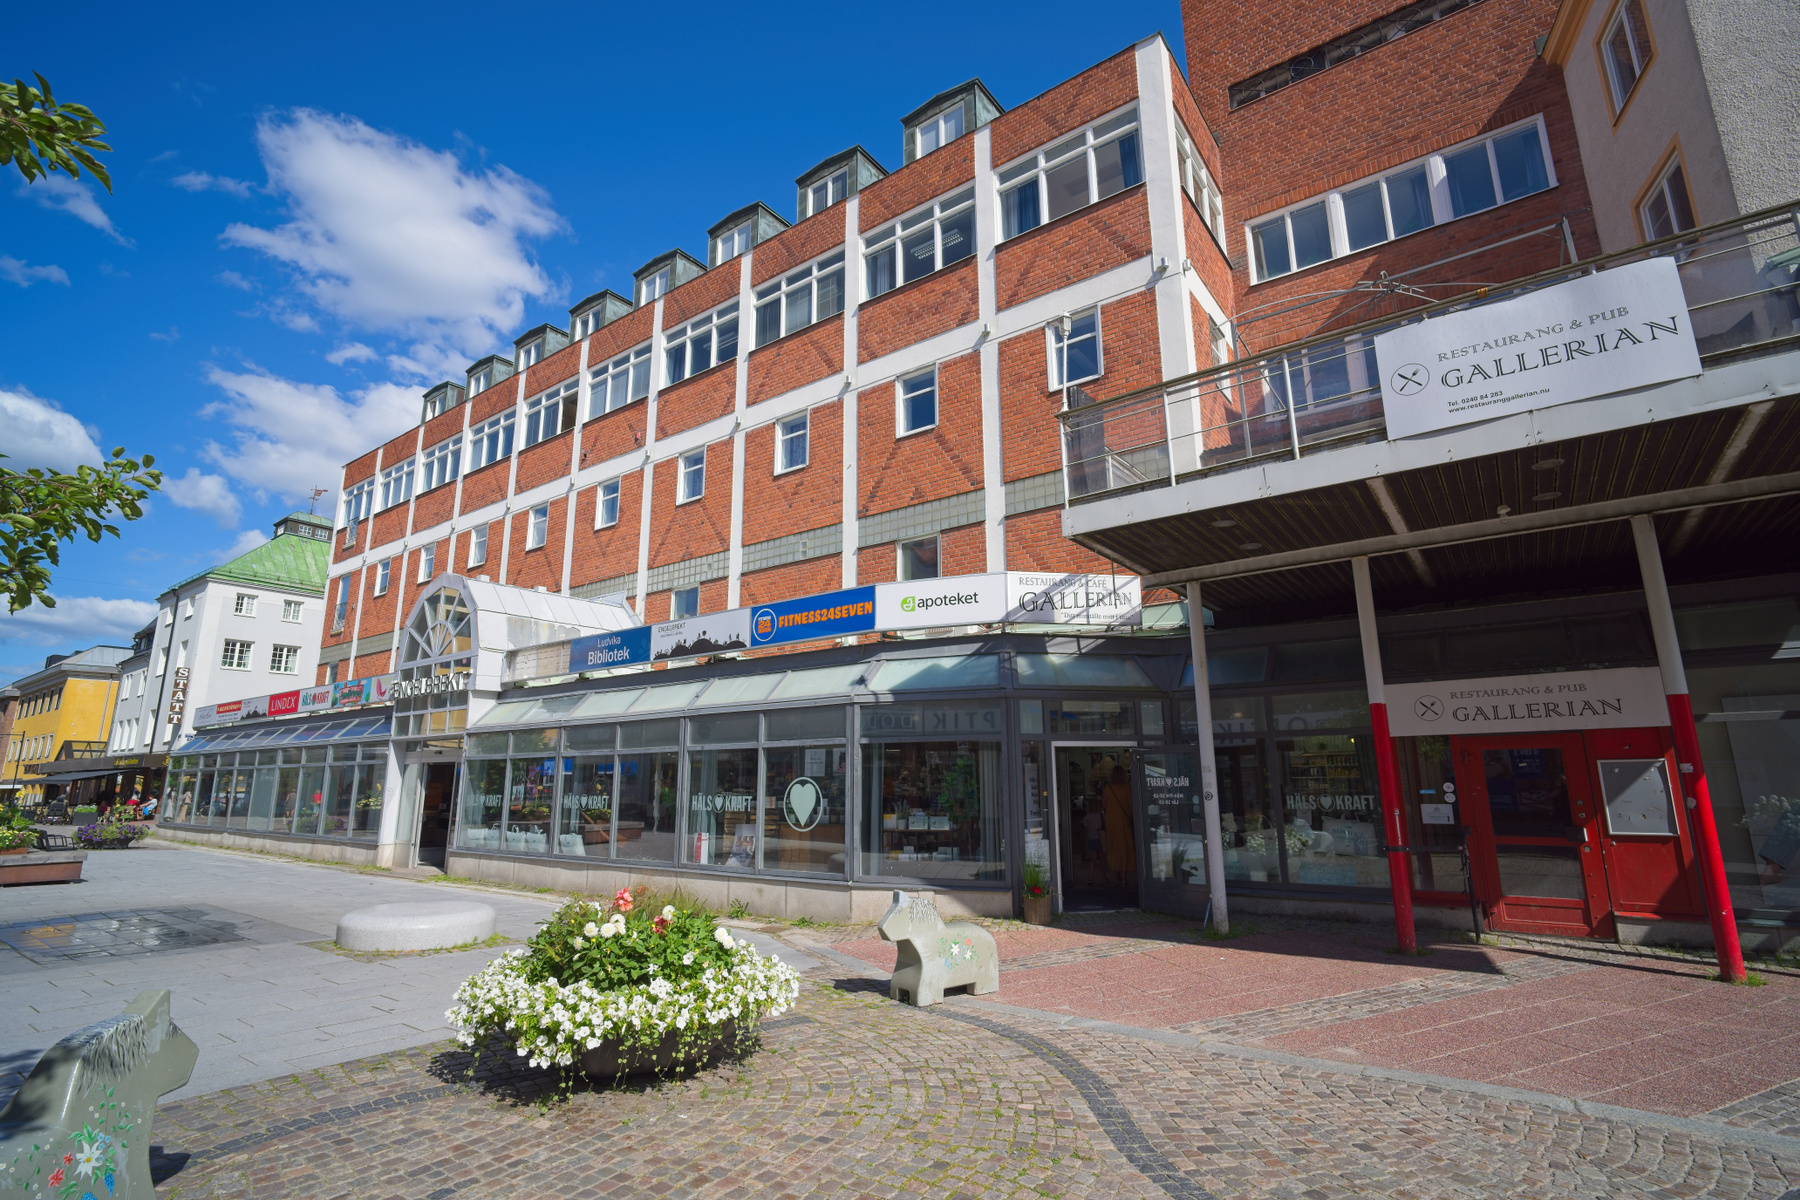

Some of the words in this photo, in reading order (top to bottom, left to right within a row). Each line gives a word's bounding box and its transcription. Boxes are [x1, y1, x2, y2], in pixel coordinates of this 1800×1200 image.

[1437, 323, 1564, 362] RESTAURANG
[1569, 319, 1584, 330] &
[1588, 306, 1629, 325] PUB
[1441, 315, 1679, 388] GALLERIAN
[1448, 387, 1550, 413] www.restauranggallerian.nu
[1461, 396, 1478, 404] 0240
[1018, 576, 1075, 588] RESTAURANG
[1077, 579, 1085, 588] &
[1087, 577, 1107, 589] CAFÉ
[917, 591, 979, 610] apoteket
[1018, 592, 1132, 612] GALLERIAN
[778, 600, 873, 628] FITNESS24SEVEN
[758, 619, 771, 628] 24
[597, 635, 621, 648] Ludvika
[587, 647, 630, 665] Bibliotek
[393, 669, 473, 699] ENGELBREKT
[1450, 686, 1540, 699] RESTAURANG
[1544, 685, 1554, 694] &
[1558, 683, 1587, 693] PUB
[171, 668, 189, 724] STATT
[271, 696, 296, 711] LINDEX
[1452, 698, 1623, 722] GALLERIAN
[725, 795, 753, 812] KRAFT
[1286, 792, 1317, 810] HÄLS
[1335, 795, 1375, 810] KRAFT
